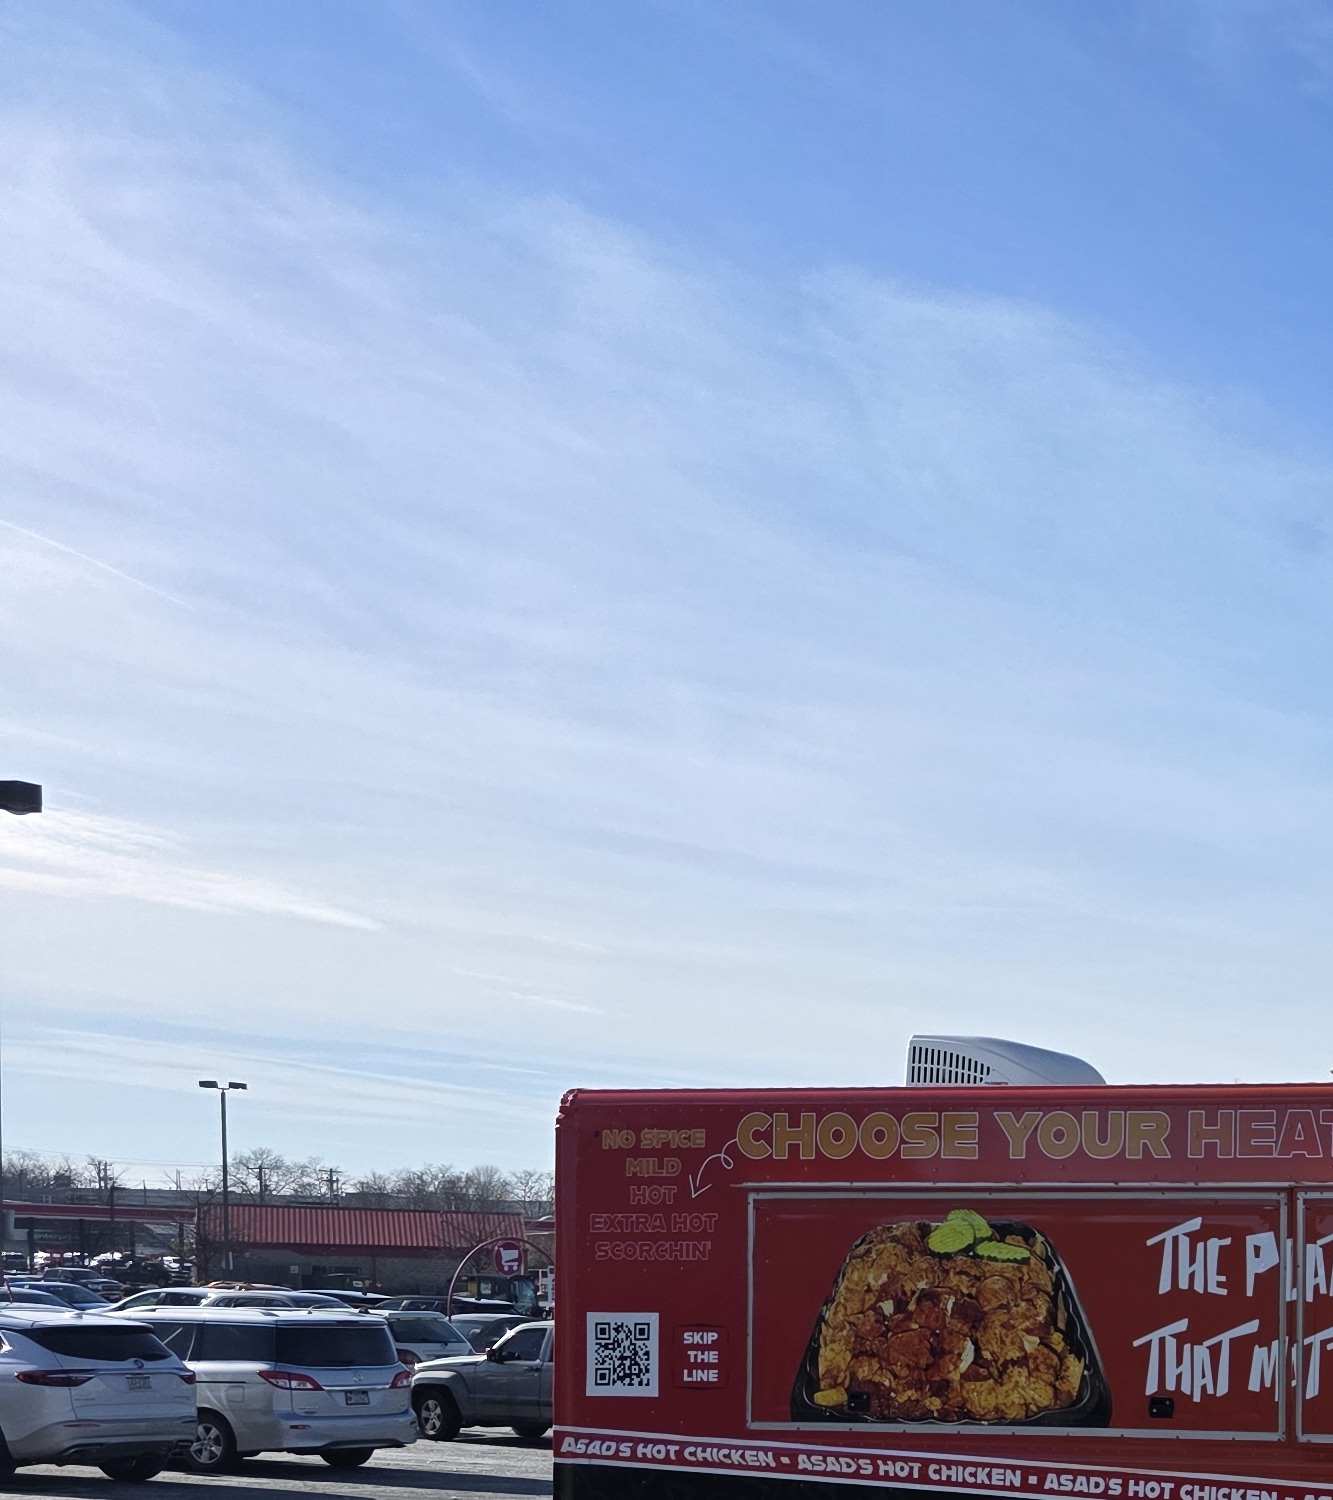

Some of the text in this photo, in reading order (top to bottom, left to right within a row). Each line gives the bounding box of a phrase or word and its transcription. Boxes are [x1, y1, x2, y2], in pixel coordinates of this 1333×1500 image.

[602, 1128, 706, 1149] NO SPICE
[736, 1111, 979, 1160] CHOOSE
[995, 1110, 1171, 1160] YOUR
[625, 1157, 682, 1177] MILD
[630, 1185, 678, 1204] HOT
[590, 1213, 719, 1233] EXTRA HOT
[595, 1241, 712, 1260] SCORCHIN'
[1146, 1216, 1232, 1296] THE
[683, 1331, 718, 1345] SKIP
[687, 1350, 719, 1363] THE
[1133, 1318, 1260, 1402] THAT
[683, 1369, 719, 1382] LINE
[560, 1437, 633, 1457] ASAD'S
[636, 1444, 680, 1460] HOT
[683, 1447, 776, 1468] CHICKEN
[797, 1454, 874, 1475] ASAD'S
[877, 1460, 922, 1479] HOT
[927, 1464, 1022, 1487] CHICKEN
[1043, 1473, 1123, 1496] ASAD'S
[1127, 1480, 1175, 1500] HOT
